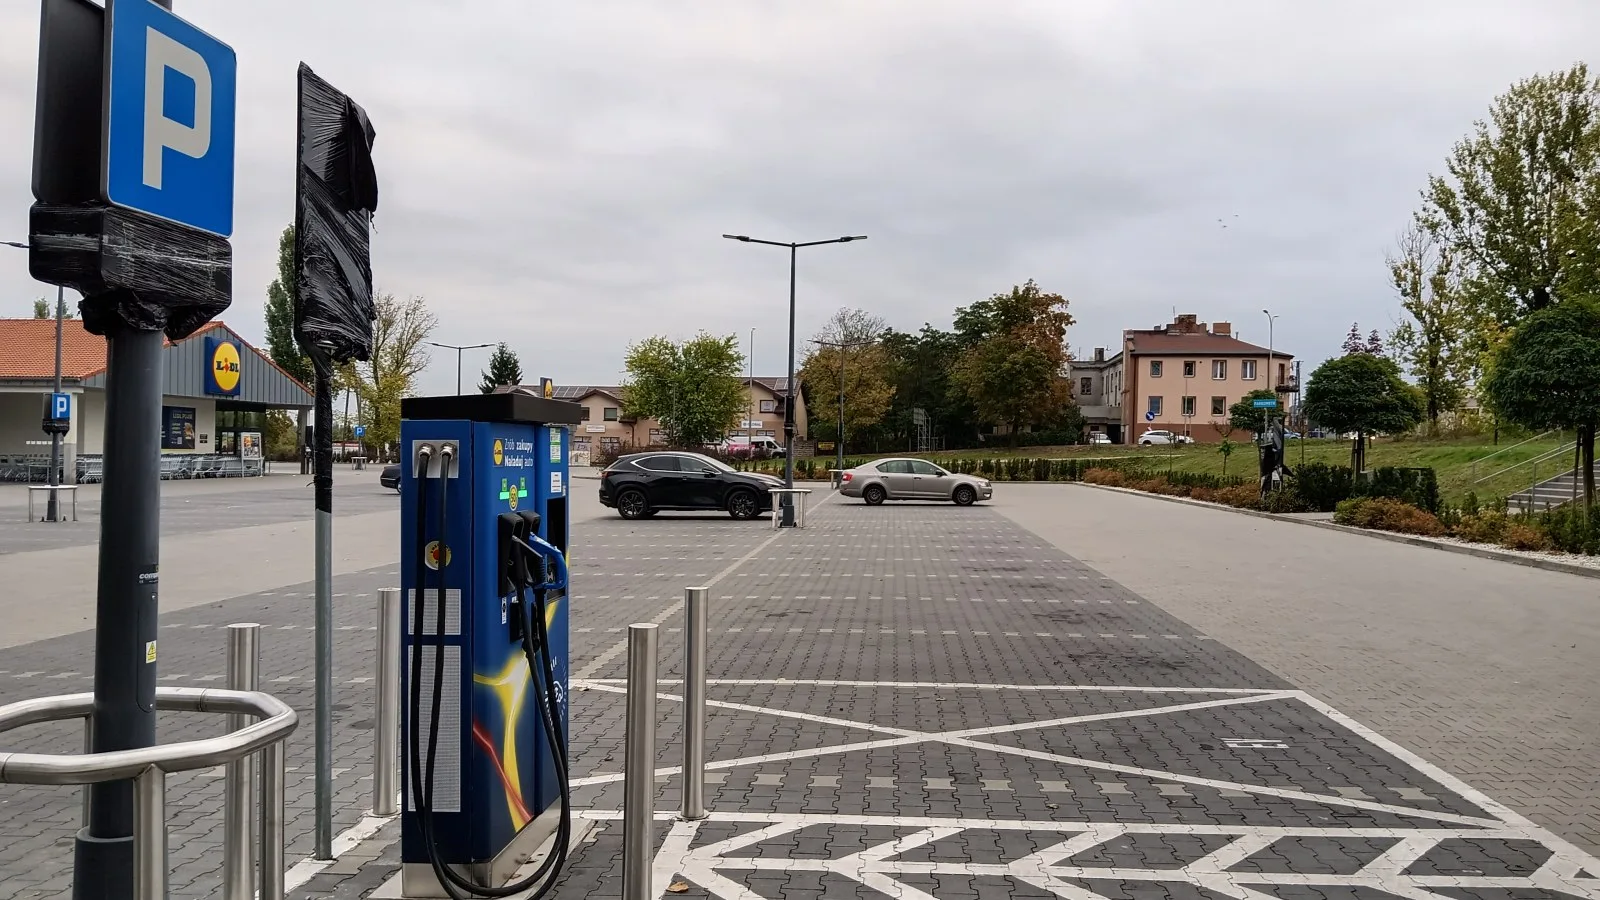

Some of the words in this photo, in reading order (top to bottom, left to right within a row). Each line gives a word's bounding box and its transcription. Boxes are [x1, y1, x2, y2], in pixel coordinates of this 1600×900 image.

[142, 25, 212, 190] P
[56, 396, 67, 418] P
[356, 427, 363, 435] P
[516, 439, 533, 453] zakupy
[524, 458, 534, 467] auto
